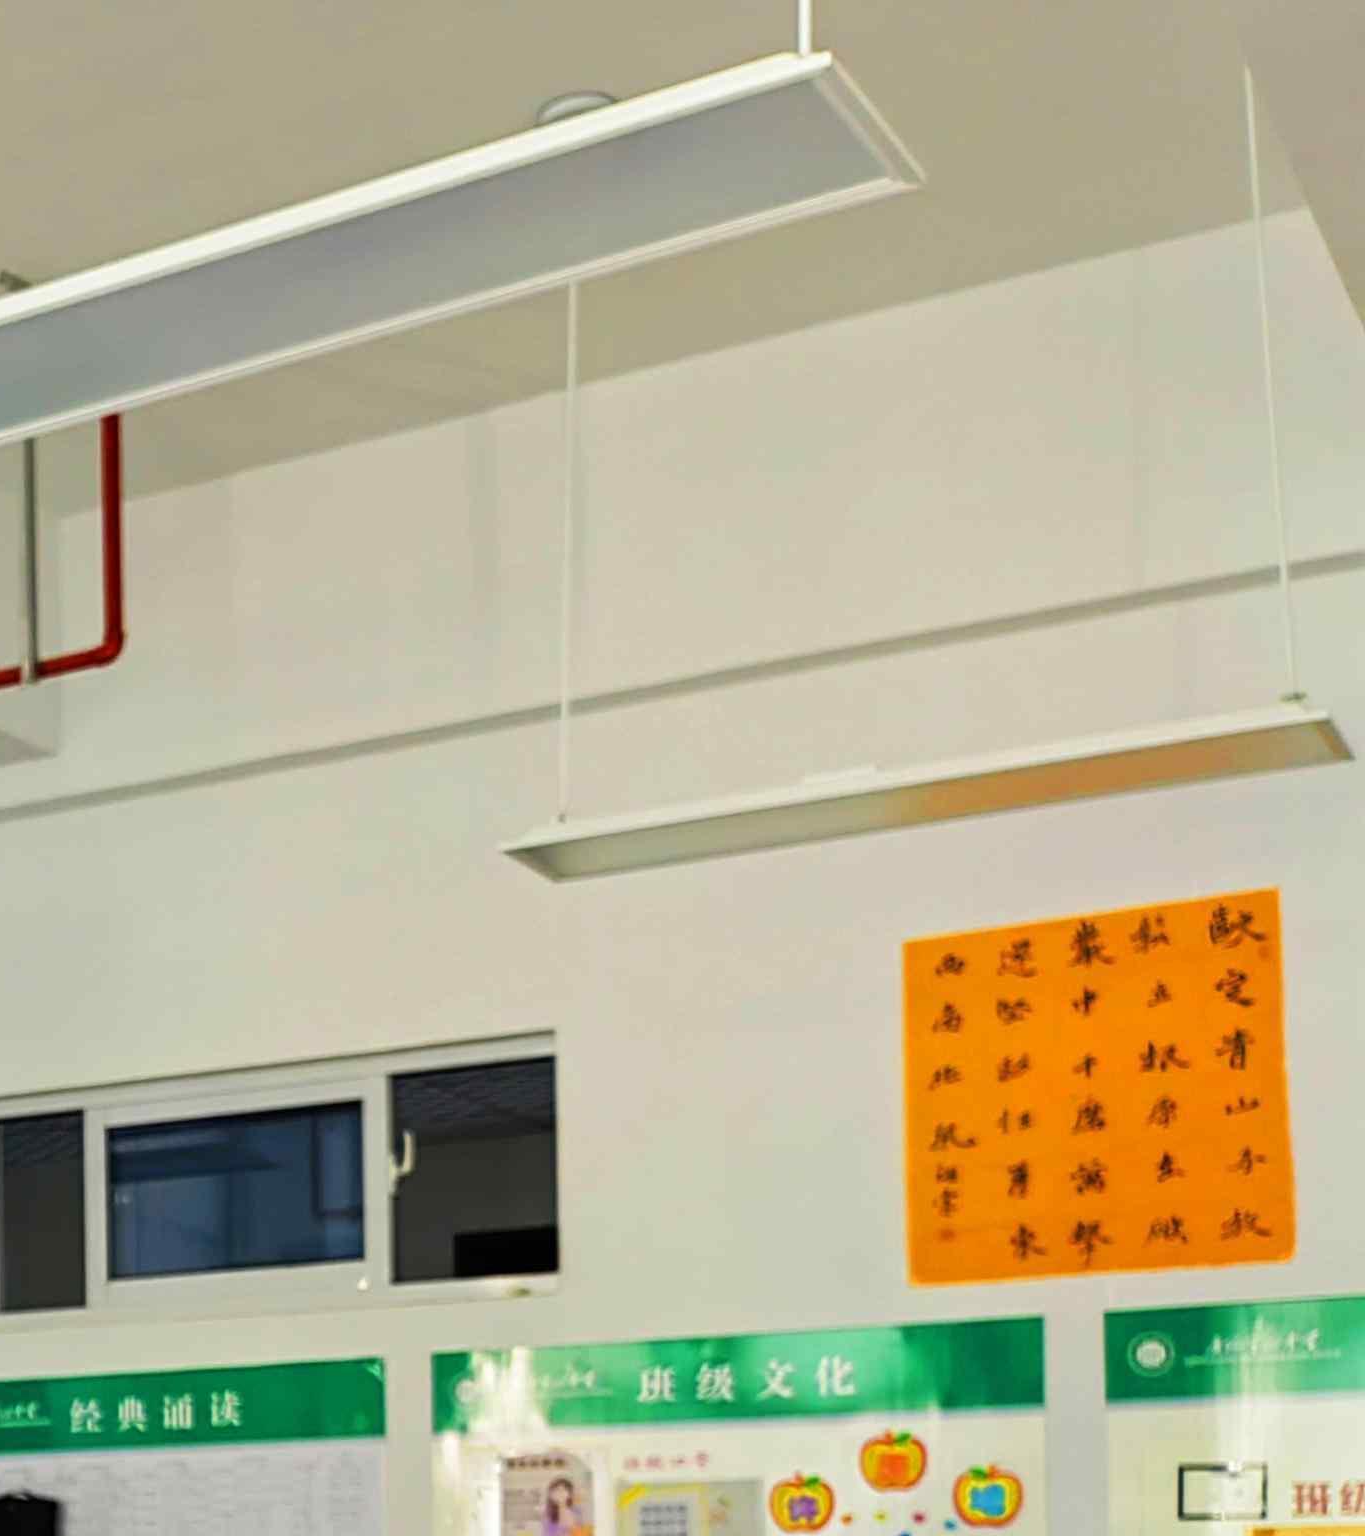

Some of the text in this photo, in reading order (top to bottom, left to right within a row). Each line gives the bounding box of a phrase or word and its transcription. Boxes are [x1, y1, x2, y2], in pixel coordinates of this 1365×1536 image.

[637, 1355, 857, 1404] 班级文化
[70, 1388, 243, 1433] 经典诵读
